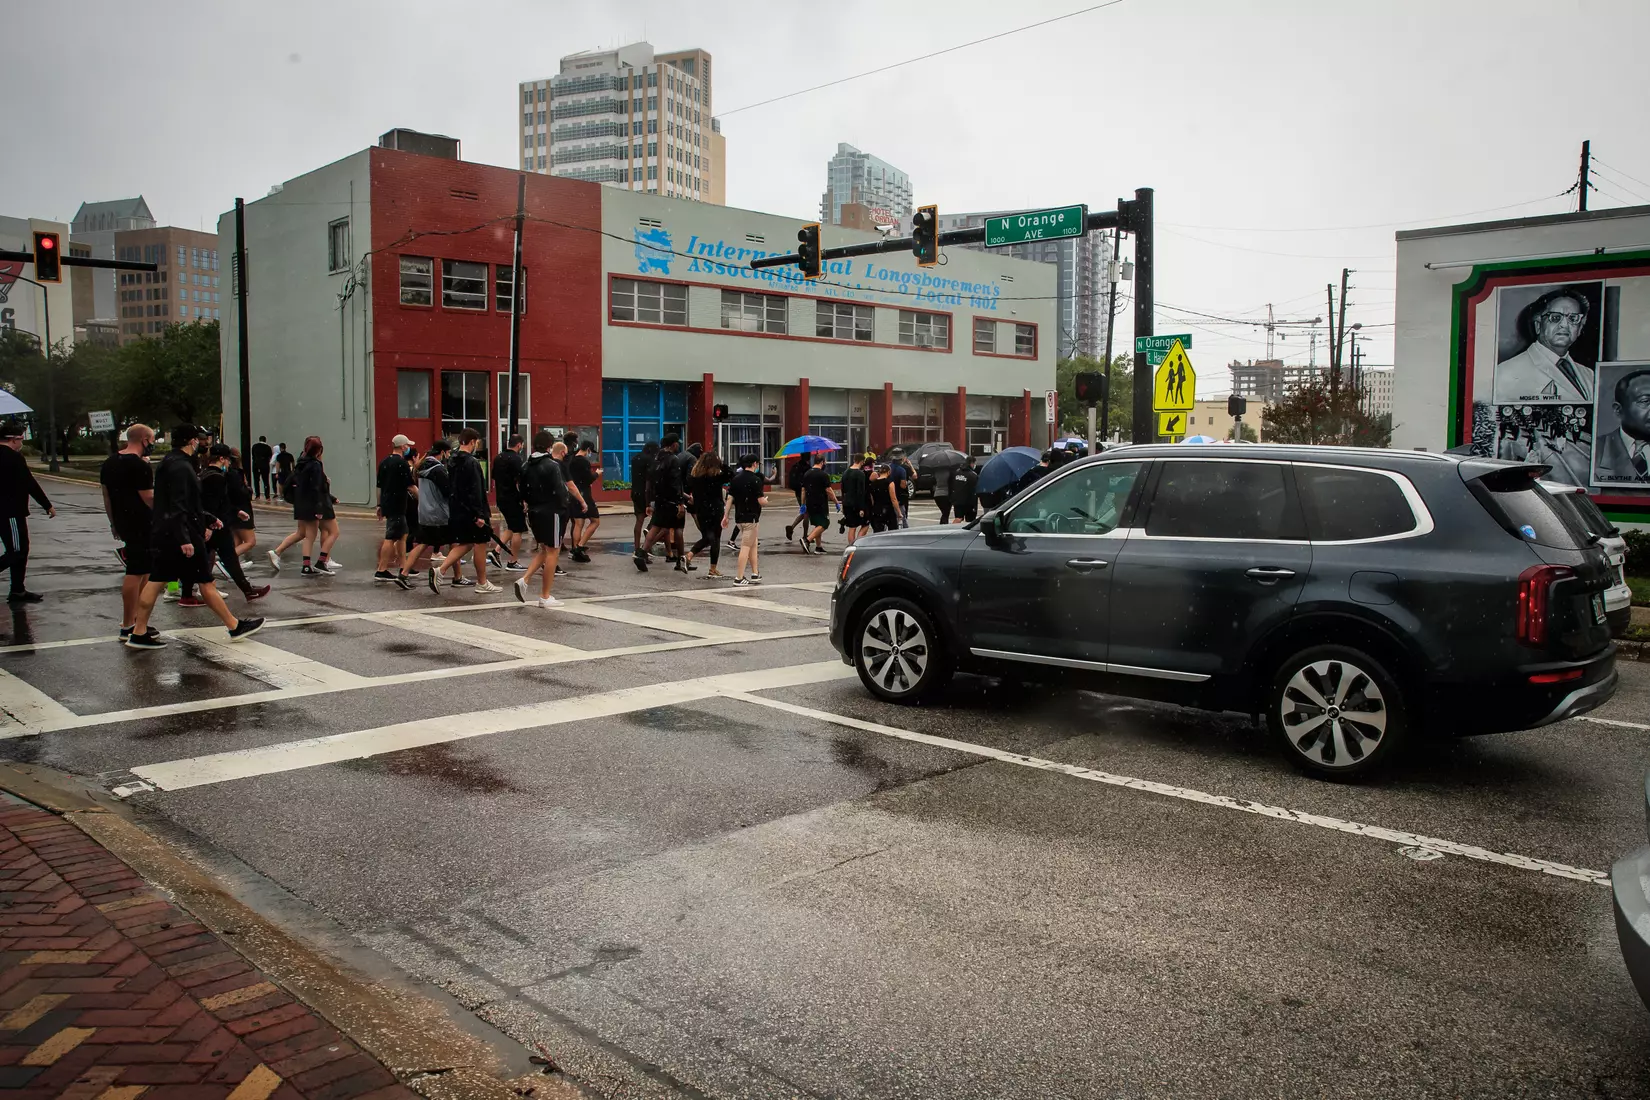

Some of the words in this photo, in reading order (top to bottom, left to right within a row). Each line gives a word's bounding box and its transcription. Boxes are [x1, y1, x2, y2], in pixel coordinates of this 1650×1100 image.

[1001, 218, 1010, 230] N
[1018, 213, 1064, 227] Orange
[990, 236, 1006, 244] 1000
[1024, 229, 1043, 240] AVE
[1063, 226, 1078, 235] 1100
[970, 294, 997, 310] 1402
[1138, 341, 1143, 349] N
